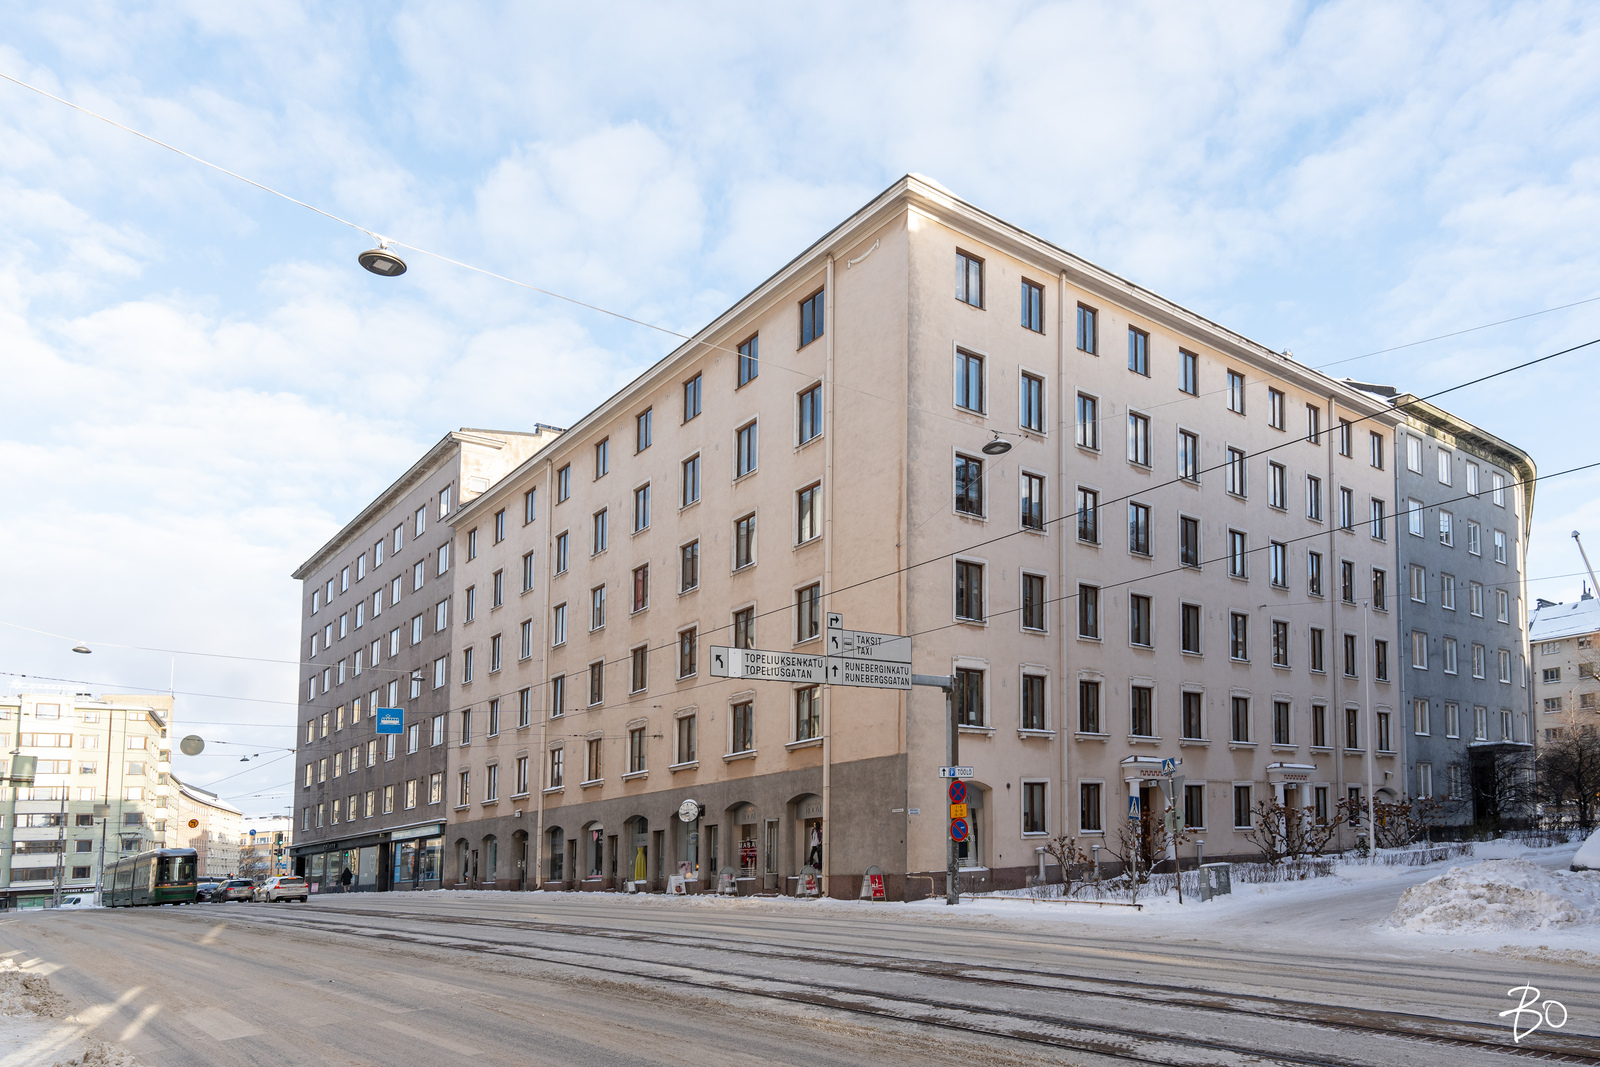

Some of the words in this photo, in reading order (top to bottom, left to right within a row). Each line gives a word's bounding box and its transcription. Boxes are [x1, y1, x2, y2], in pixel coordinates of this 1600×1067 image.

[856, 635, 882, 646] TAKSIT
[856, 645, 873, 656] TAXI
[744, 653, 823, 668] TOPELIUKSENKATU
[744, 665, 812, 679] TOPELIUSGATAN
[845, 662, 909, 675] RUNEBERGINKATU
[845, 673, 910, 685] RUNEBERGSGATAN
